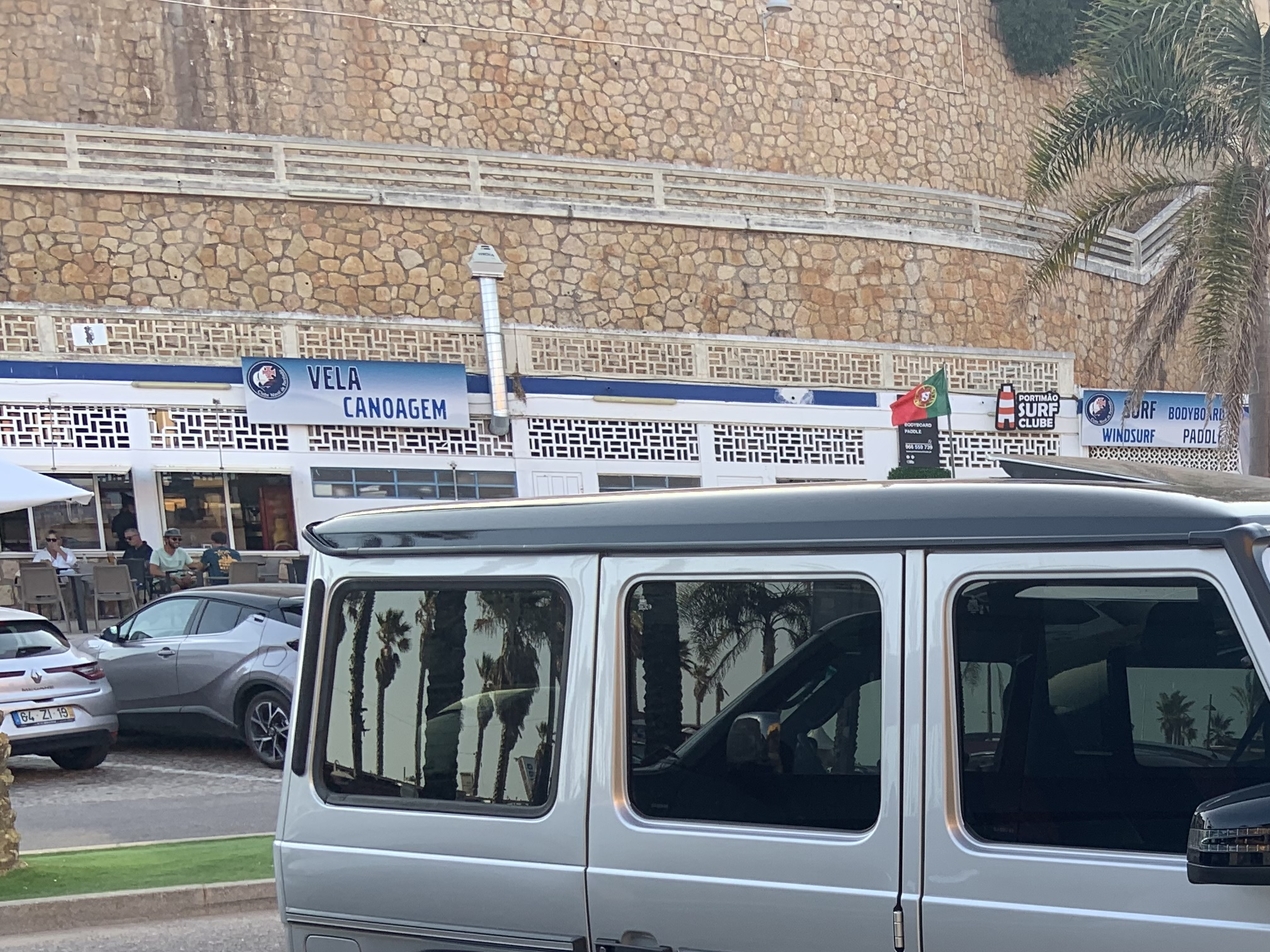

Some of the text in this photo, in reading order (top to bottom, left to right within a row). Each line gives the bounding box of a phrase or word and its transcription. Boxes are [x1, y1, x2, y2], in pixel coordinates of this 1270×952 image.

[307, 365, 362, 391] VELA
[1018, 394, 1059, 402] PORTIMÃO
[343, 396, 448, 420] CANOAGEM
[1018, 402, 1059, 418] SURF
[1018, 418, 1054, 428] CLUBE
[1102, 428, 1156, 443] WINDSURF
